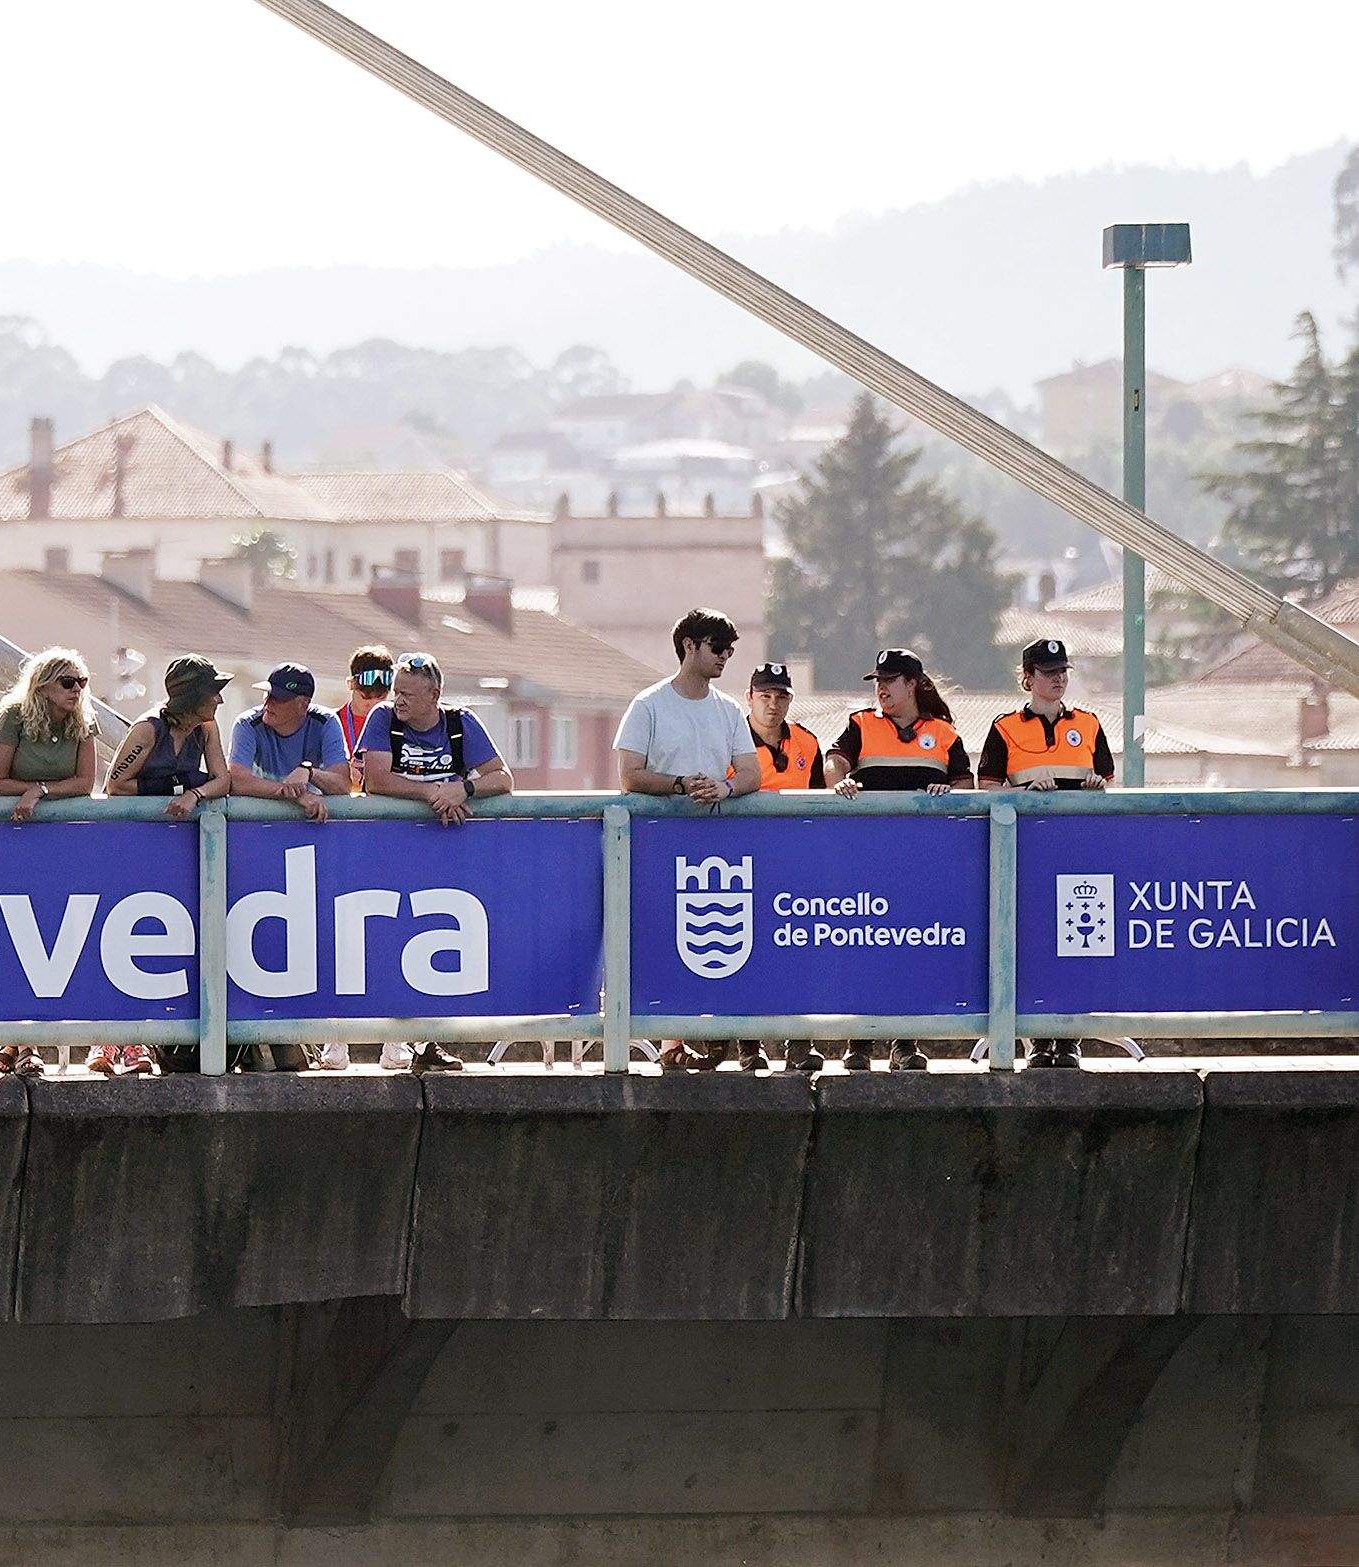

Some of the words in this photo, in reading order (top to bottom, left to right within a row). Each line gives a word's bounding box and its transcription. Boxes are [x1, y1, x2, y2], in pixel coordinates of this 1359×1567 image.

[773, 891, 889, 917] Concello
[1128, 880, 1257, 912] XUNTA
[773, 922, 809, 947] de
[814, 921, 966, 947] Pontevedra
[1128, 917, 1175, 949] DE
[1188, 917, 1337, 949] GALICIA
